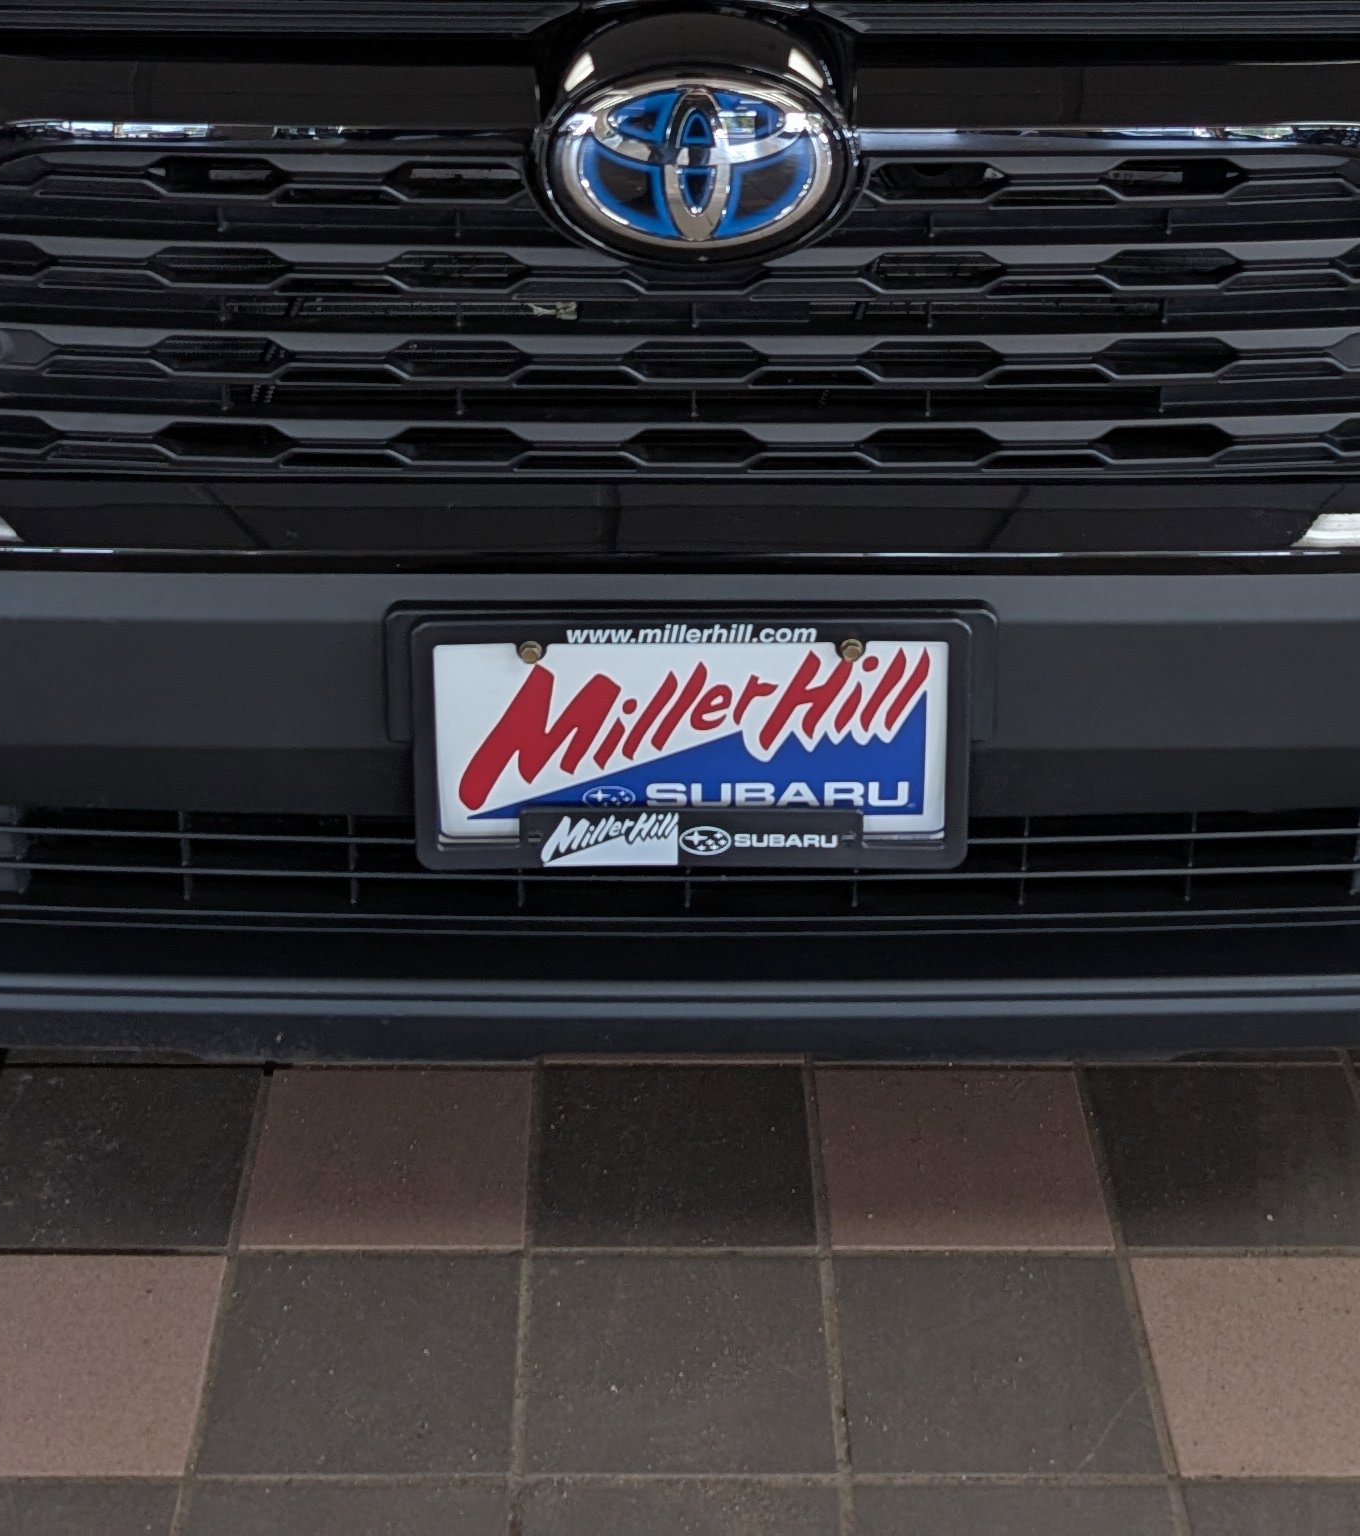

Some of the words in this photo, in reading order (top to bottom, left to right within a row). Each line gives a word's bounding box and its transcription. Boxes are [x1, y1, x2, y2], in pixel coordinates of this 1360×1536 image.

[566, 623, 818, 644] www.millerhill.com
[458, 661, 778, 810] Miller
[759, 647, 930, 750] Hill
[645, 781, 910, 807] SUBARU
[541, 815, 636, 863] Miller
[630, 812, 679, 844] Hill
[734, 834, 838, 848] SUBARU
